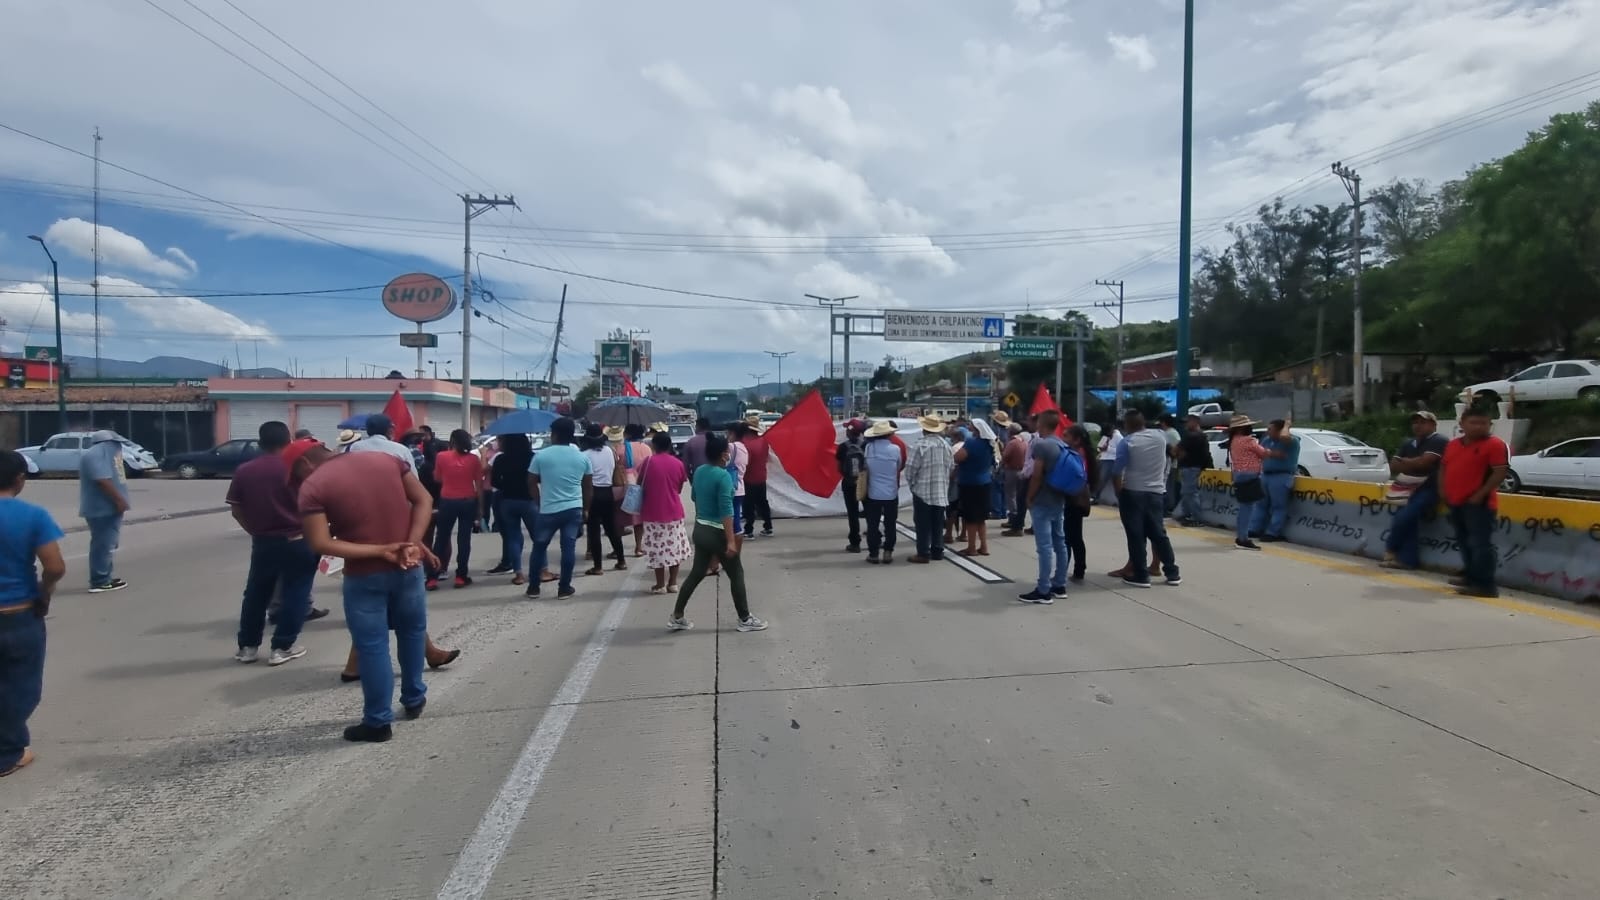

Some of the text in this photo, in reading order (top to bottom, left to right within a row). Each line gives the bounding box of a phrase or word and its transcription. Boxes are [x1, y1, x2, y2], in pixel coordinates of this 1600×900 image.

[389, 287, 444, 303] SHOP
[887, 314, 983, 328] BIENVENIDOS A CHILPANCINGO
[1296, 515, 1364, 541] nuestros
[1524, 517, 1564, 541] que
